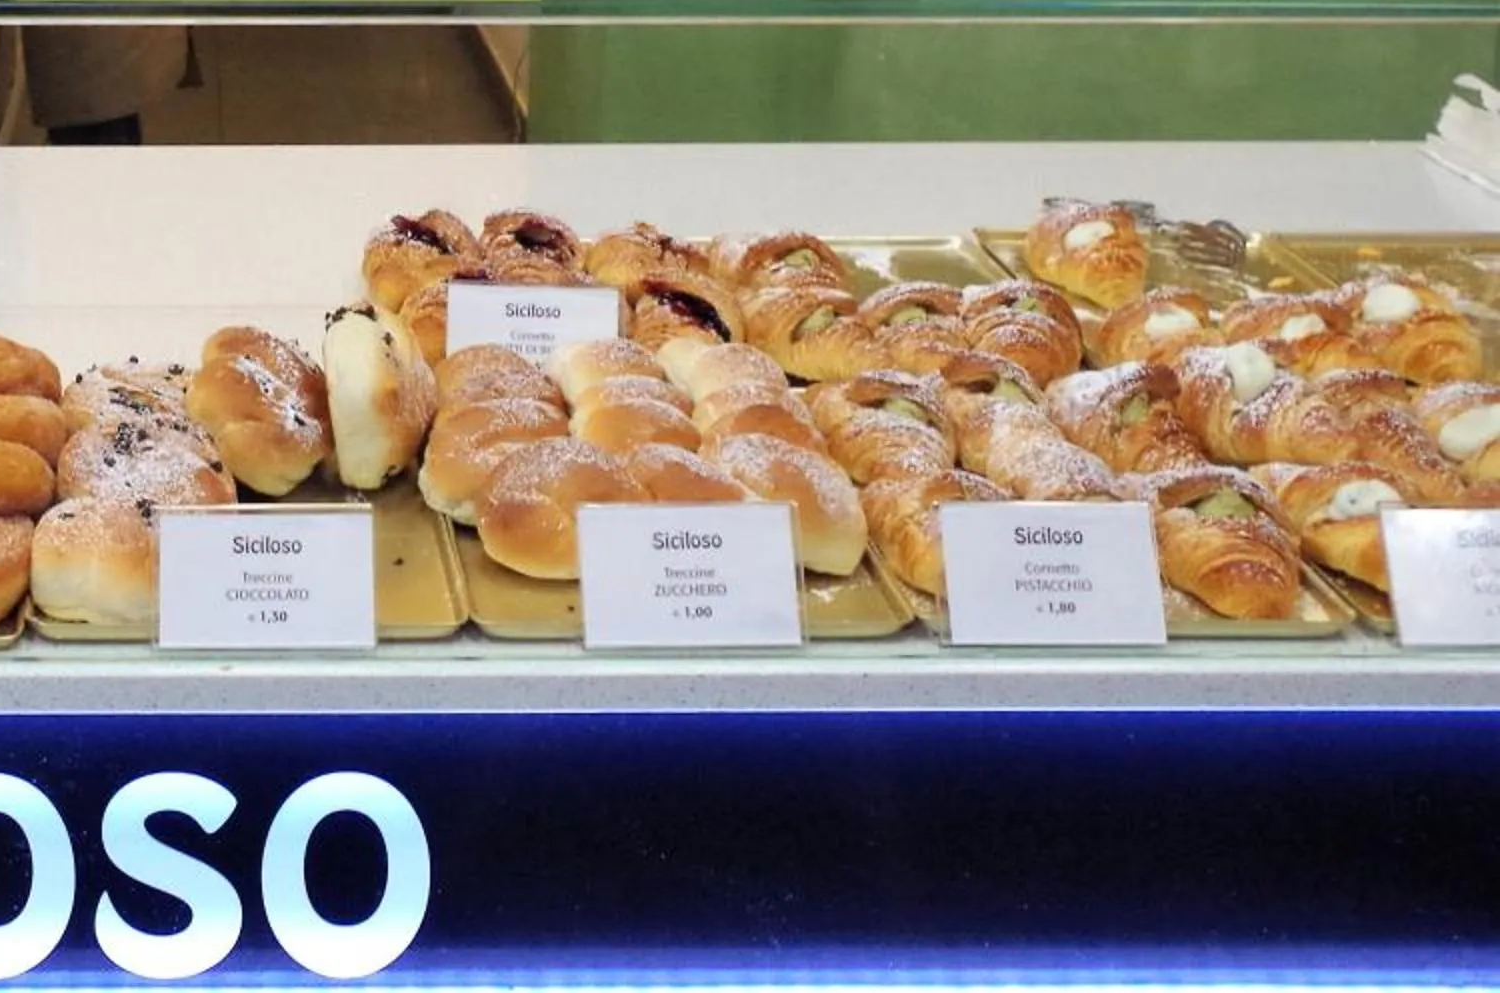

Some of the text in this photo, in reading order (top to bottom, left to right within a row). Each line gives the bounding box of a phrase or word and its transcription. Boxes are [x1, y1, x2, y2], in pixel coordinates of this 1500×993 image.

[505, 303, 561, 318] Siciloso
[653, 531, 722, 550] Siciloso
[1014, 527, 1083, 545] Siciloso
[233, 536, 302, 555] Siciloso
[664, 567, 715, 579] Treccine
[1024, 562, 1080, 575] Cornetto
[243, 571, 292, 584] Treccine
[655, 583, 727, 597] ZUCCHERO
[1015, 579, 1092, 592] PISTACCHIO
[225, 588, 309, 601] CIOCCOLATO
